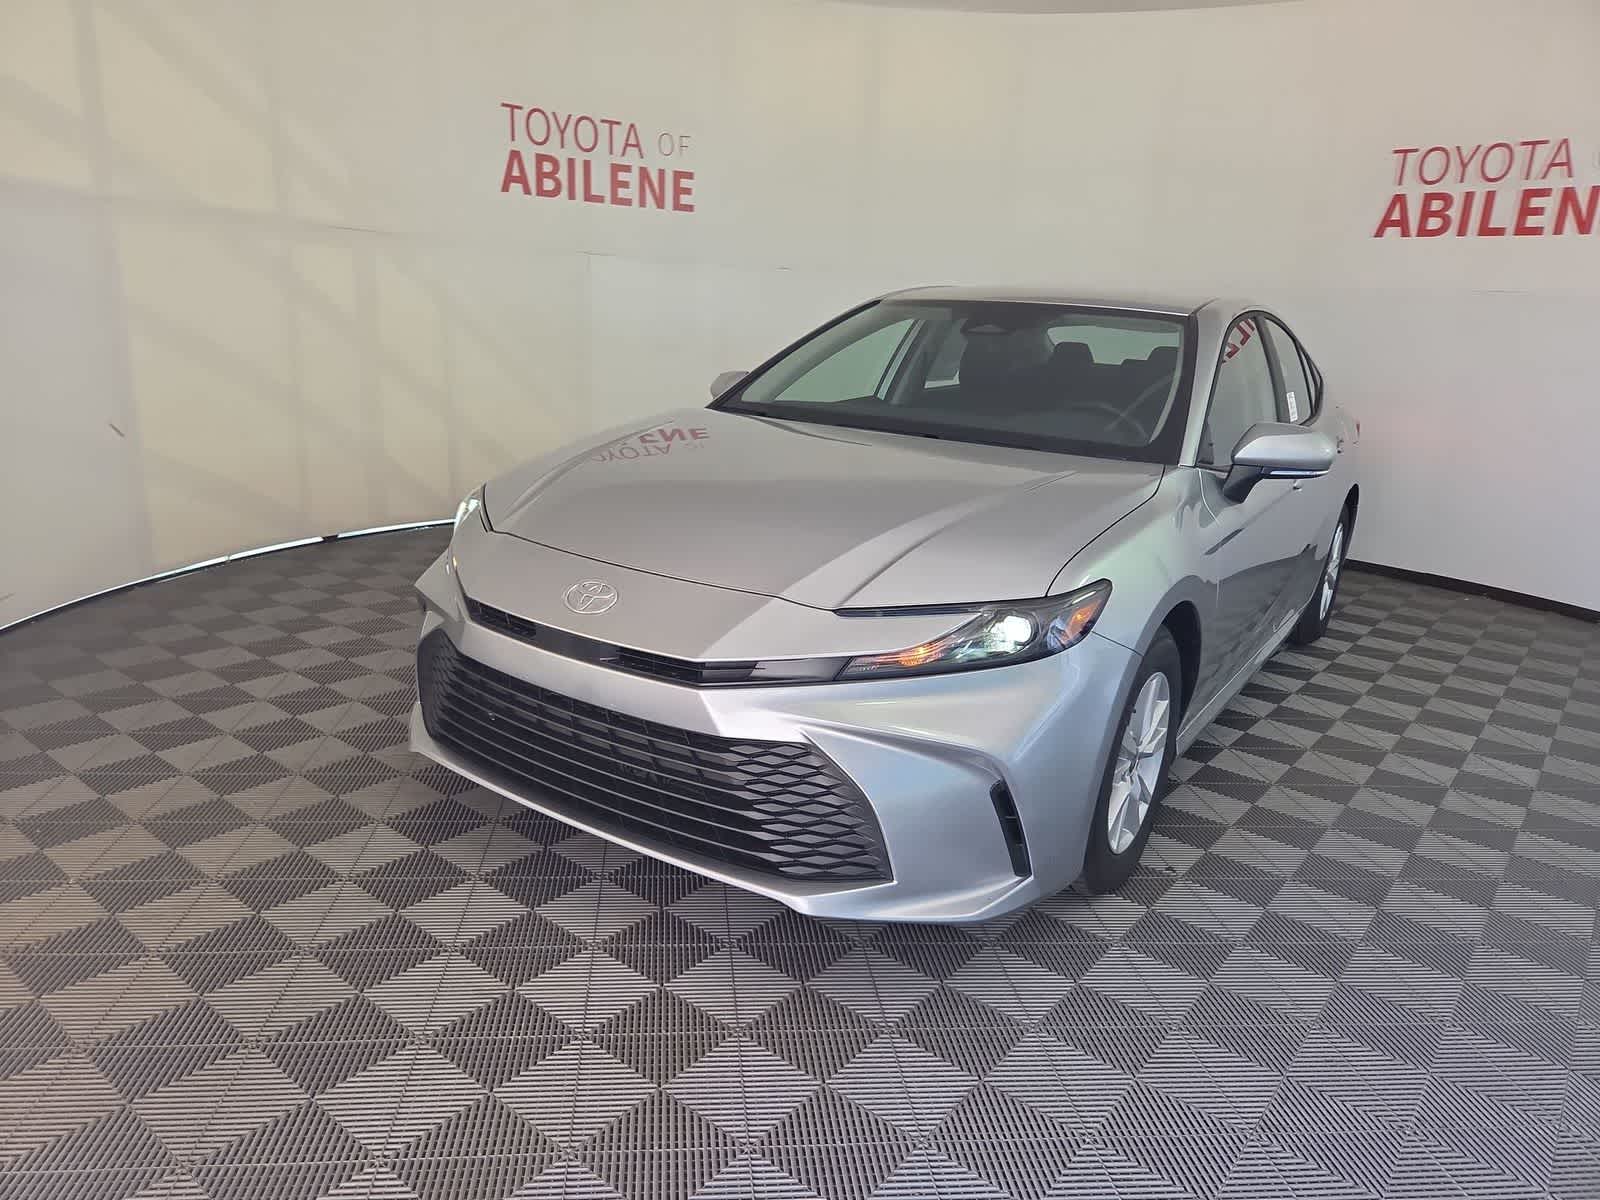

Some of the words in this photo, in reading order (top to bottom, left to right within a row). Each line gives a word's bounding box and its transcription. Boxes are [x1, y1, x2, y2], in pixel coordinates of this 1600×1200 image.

[501, 102, 644, 159] TOYOTA
[657, 132, 691, 156] OF
[501, 149, 695, 212] ABILENE
[1392, 138, 1574, 186] TOYOTA
[1373, 185, 1600, 238] ABILEN
